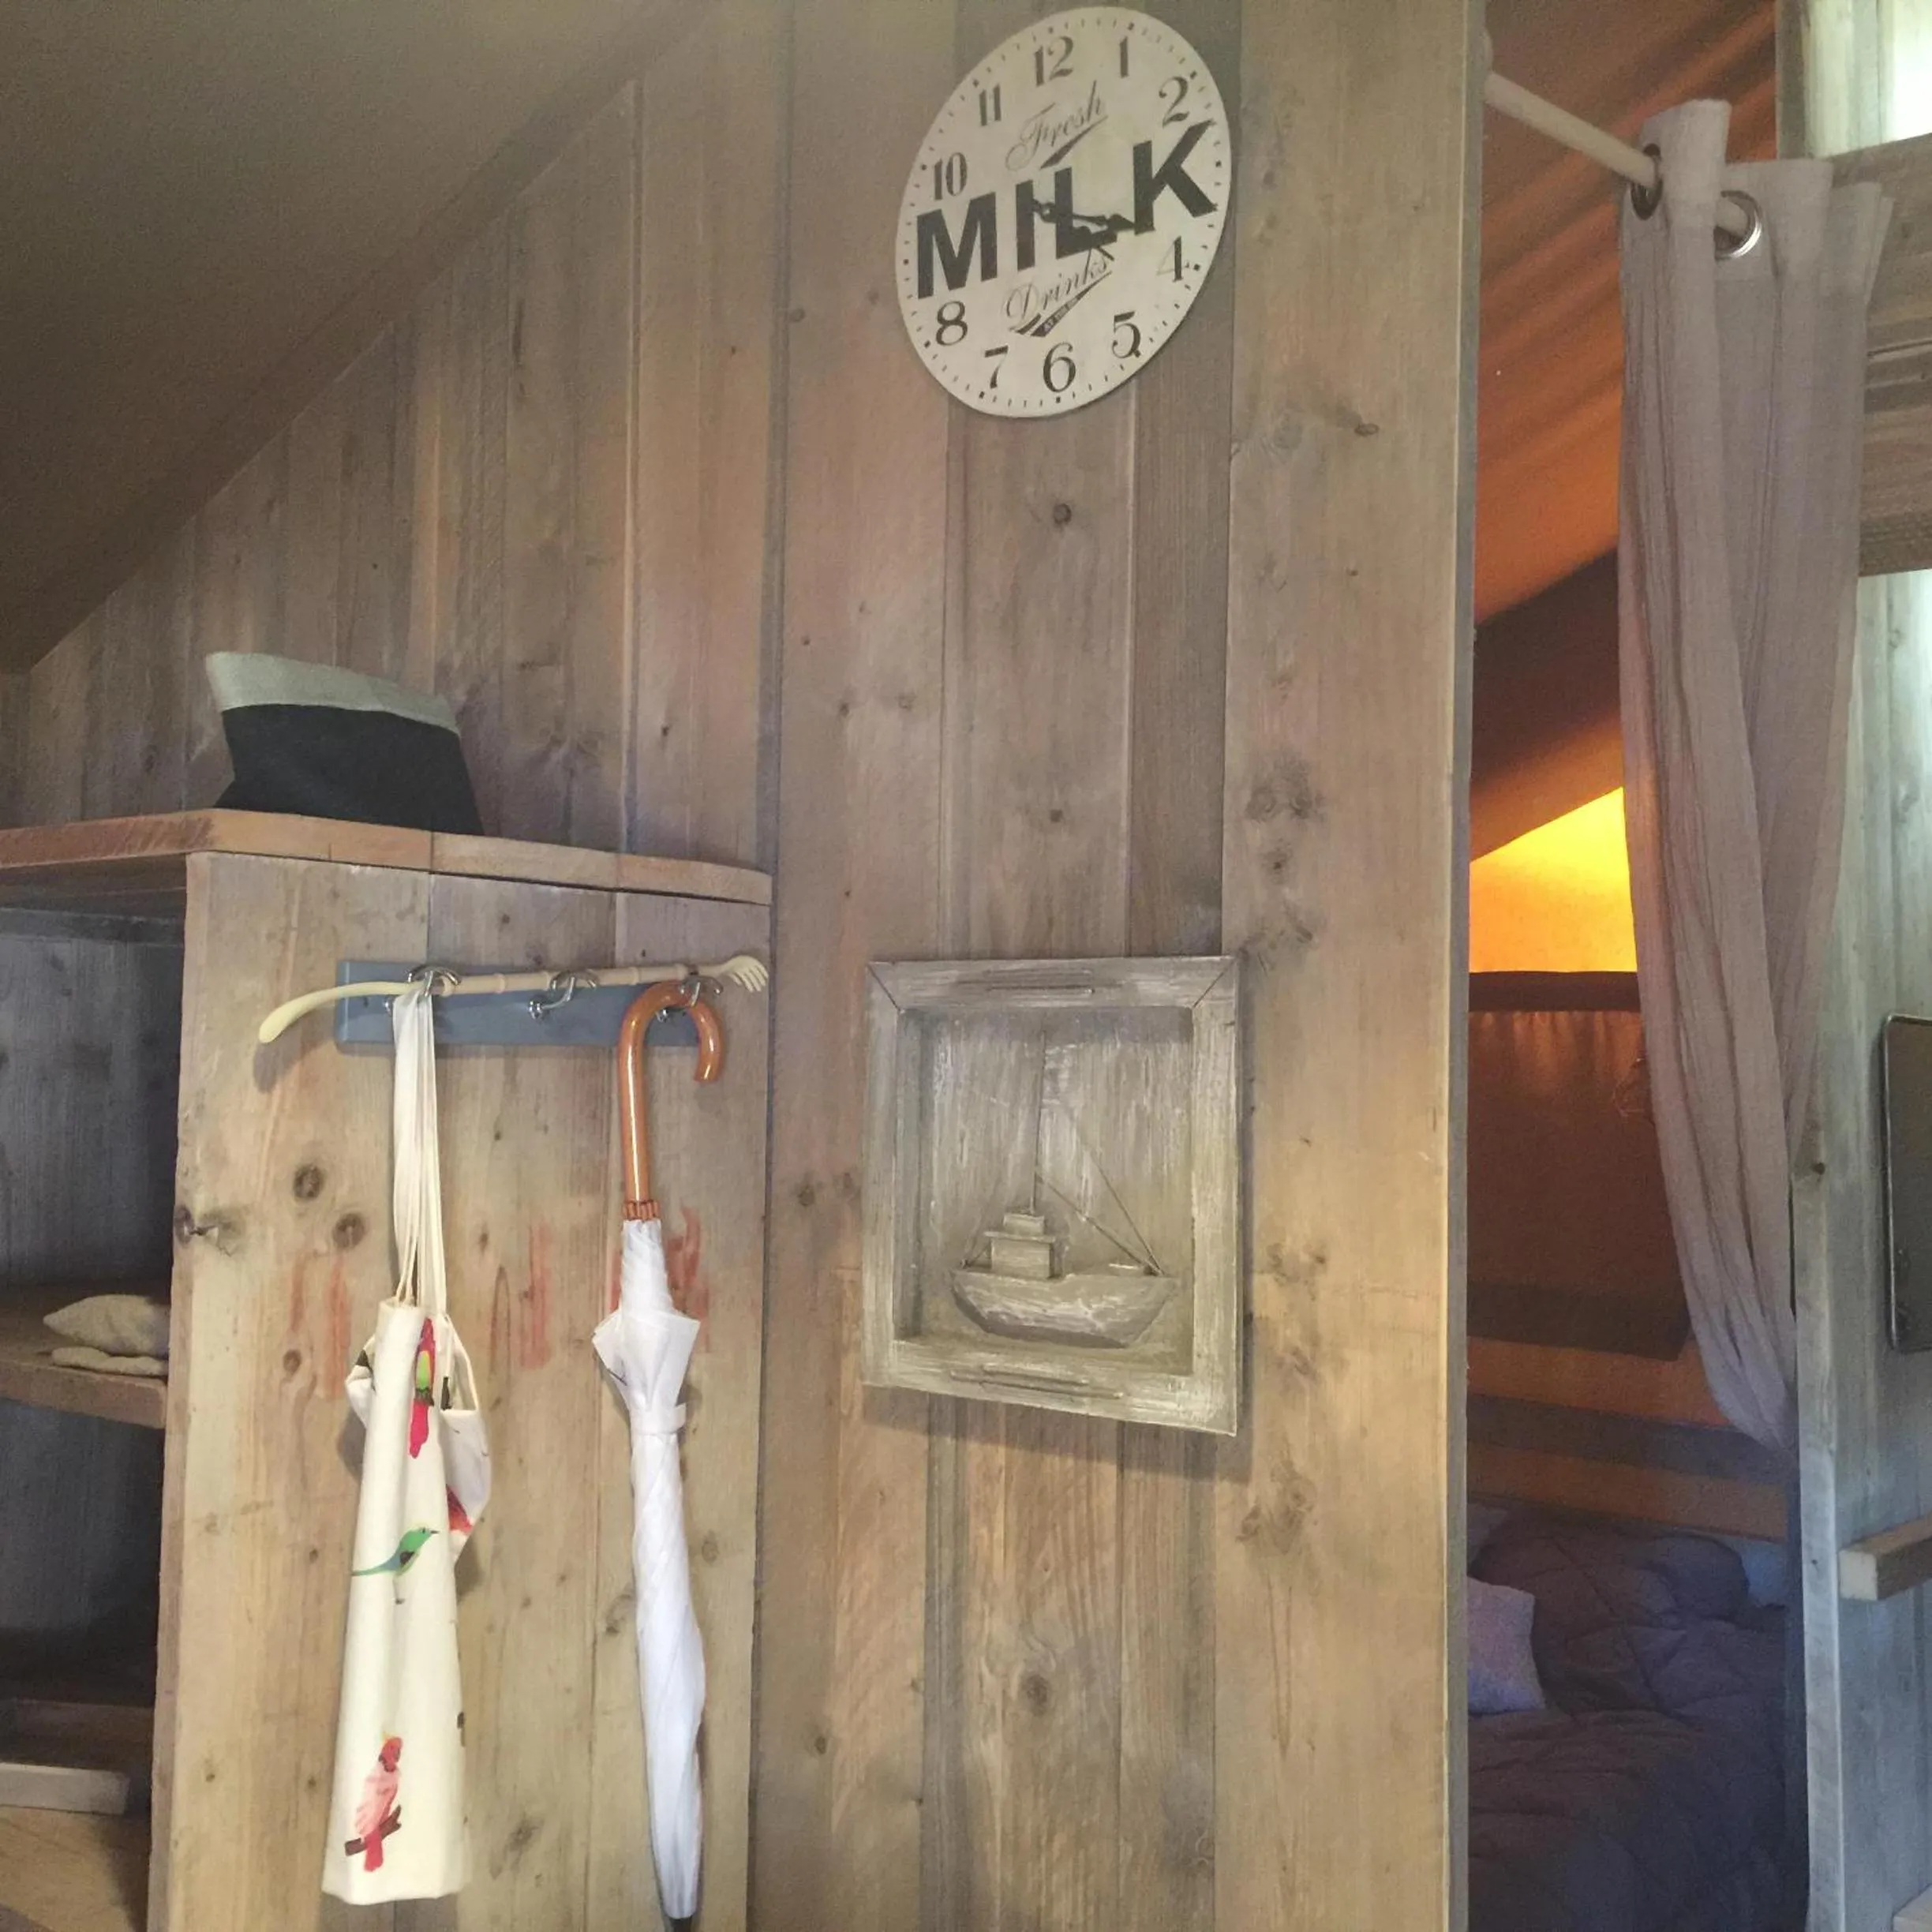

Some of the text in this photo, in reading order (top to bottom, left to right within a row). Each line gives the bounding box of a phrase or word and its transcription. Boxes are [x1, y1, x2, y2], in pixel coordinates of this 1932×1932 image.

[1033, 36, 1074, 87] 12
[1119, 36, 1129, 78] 1
[978, 84, 1002, 127] 11
[1005, 80, 1106, 171] Fresh
[1158, 76, 1190, 129] 2
[933, 152, 968, 201] 10
[916, 118, 1219, 300] MILK
[1155, 236, 1189, 283] 4
[1005, 248, 1112, 327] Drinks
[935, 301, 969, 346] 8
[1111, 310, 1143, 360] 5
[983, 345, 1009, 390] 7
[1042, 341, 1077, 394] 6
